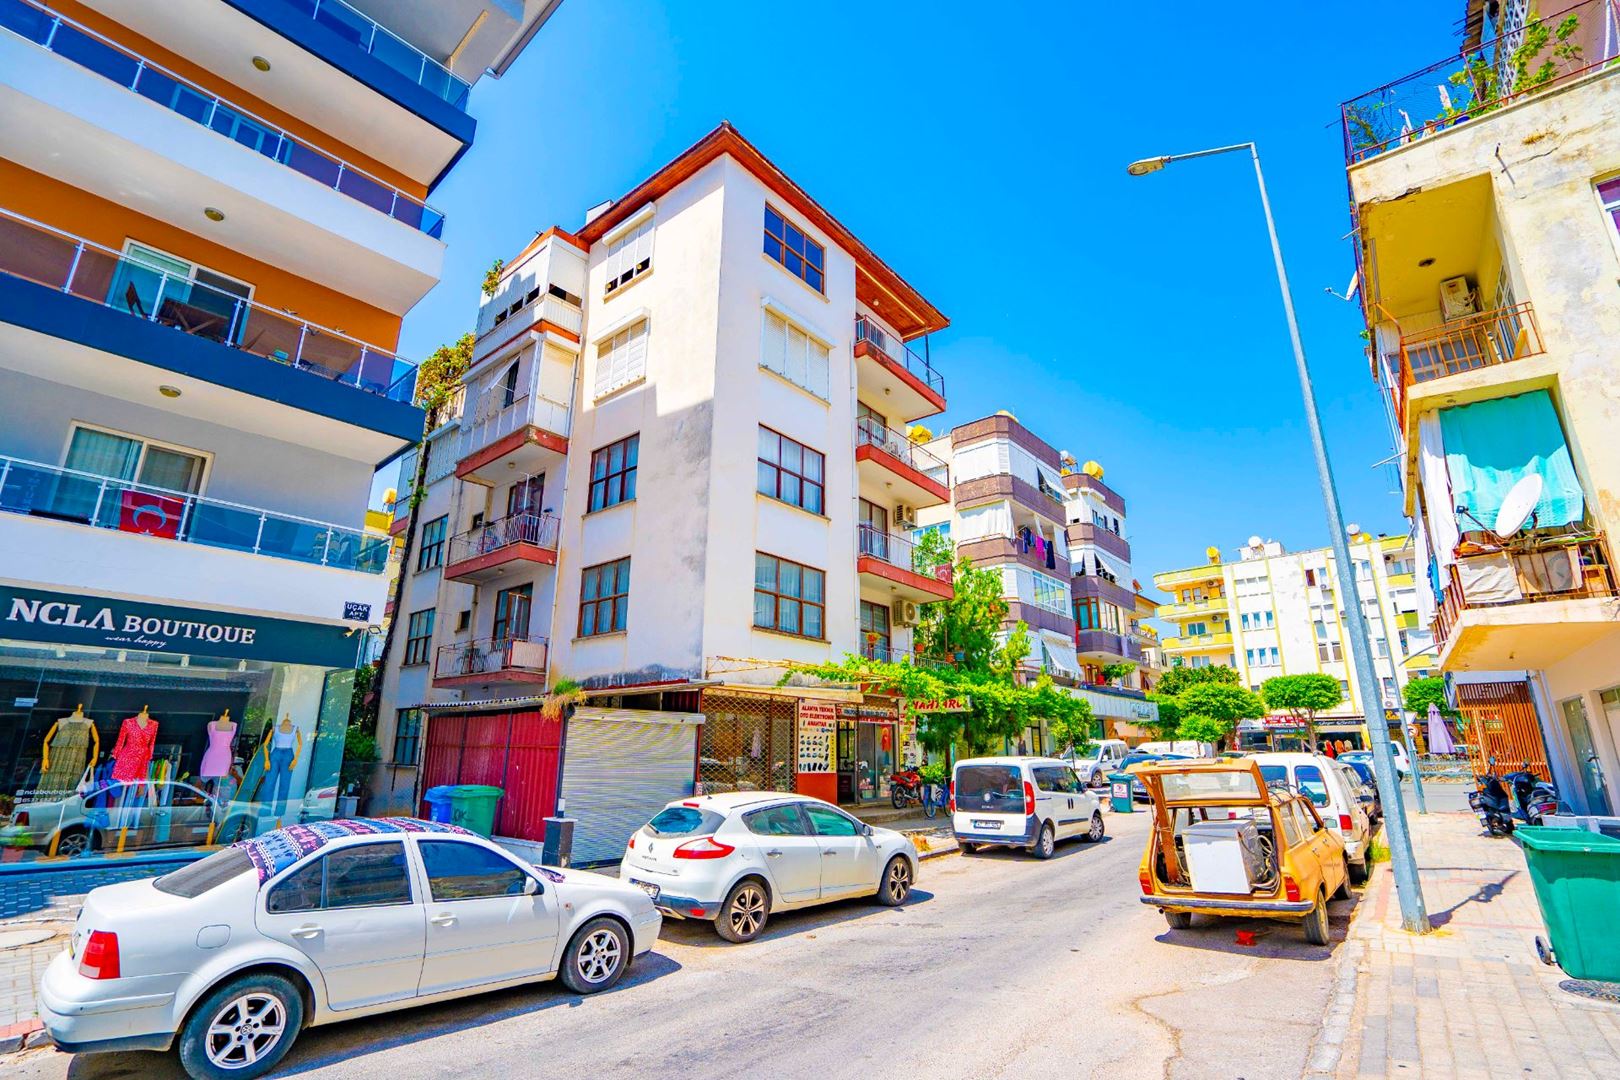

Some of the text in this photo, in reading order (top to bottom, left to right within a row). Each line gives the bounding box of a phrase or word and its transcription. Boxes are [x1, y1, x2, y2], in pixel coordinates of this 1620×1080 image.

[6, 598, 257, 644] NCLA BOUTIQUE
[134, 634, 167, 649] happy
